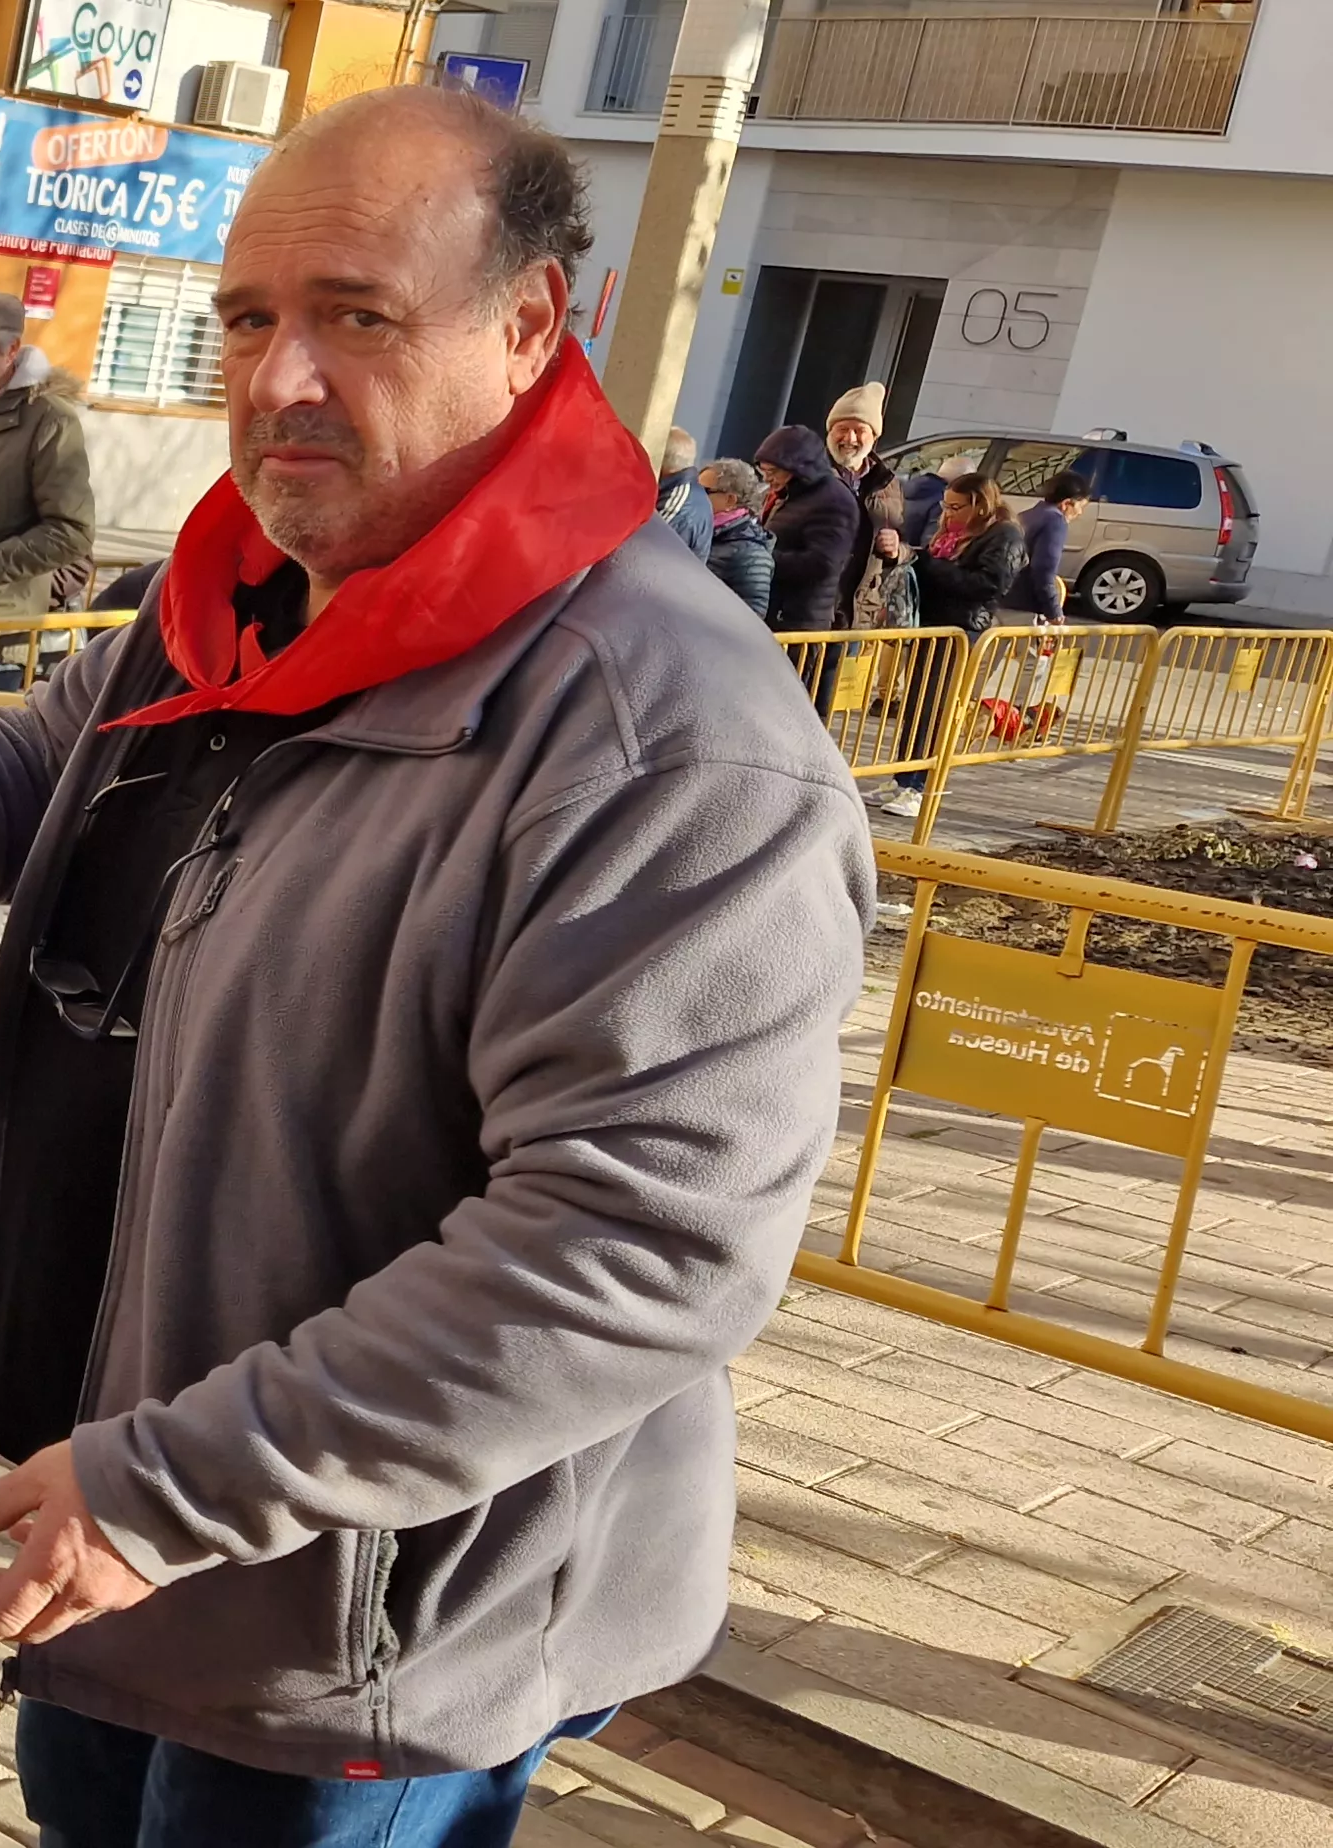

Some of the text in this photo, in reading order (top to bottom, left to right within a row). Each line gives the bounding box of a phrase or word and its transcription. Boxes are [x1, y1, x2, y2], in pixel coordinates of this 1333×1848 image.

[72, 2, 156, 66] Goya
[47, 121, 155, 164] OFERTÓN
[26, 165, 128, 218] TEÓRICA
[54, 217, 90, 237] CLASES
[91, 223, 104, 239] DE
[118, 227, 161, 248] MINUTOS
[961, 288, 1059, 350] 05
